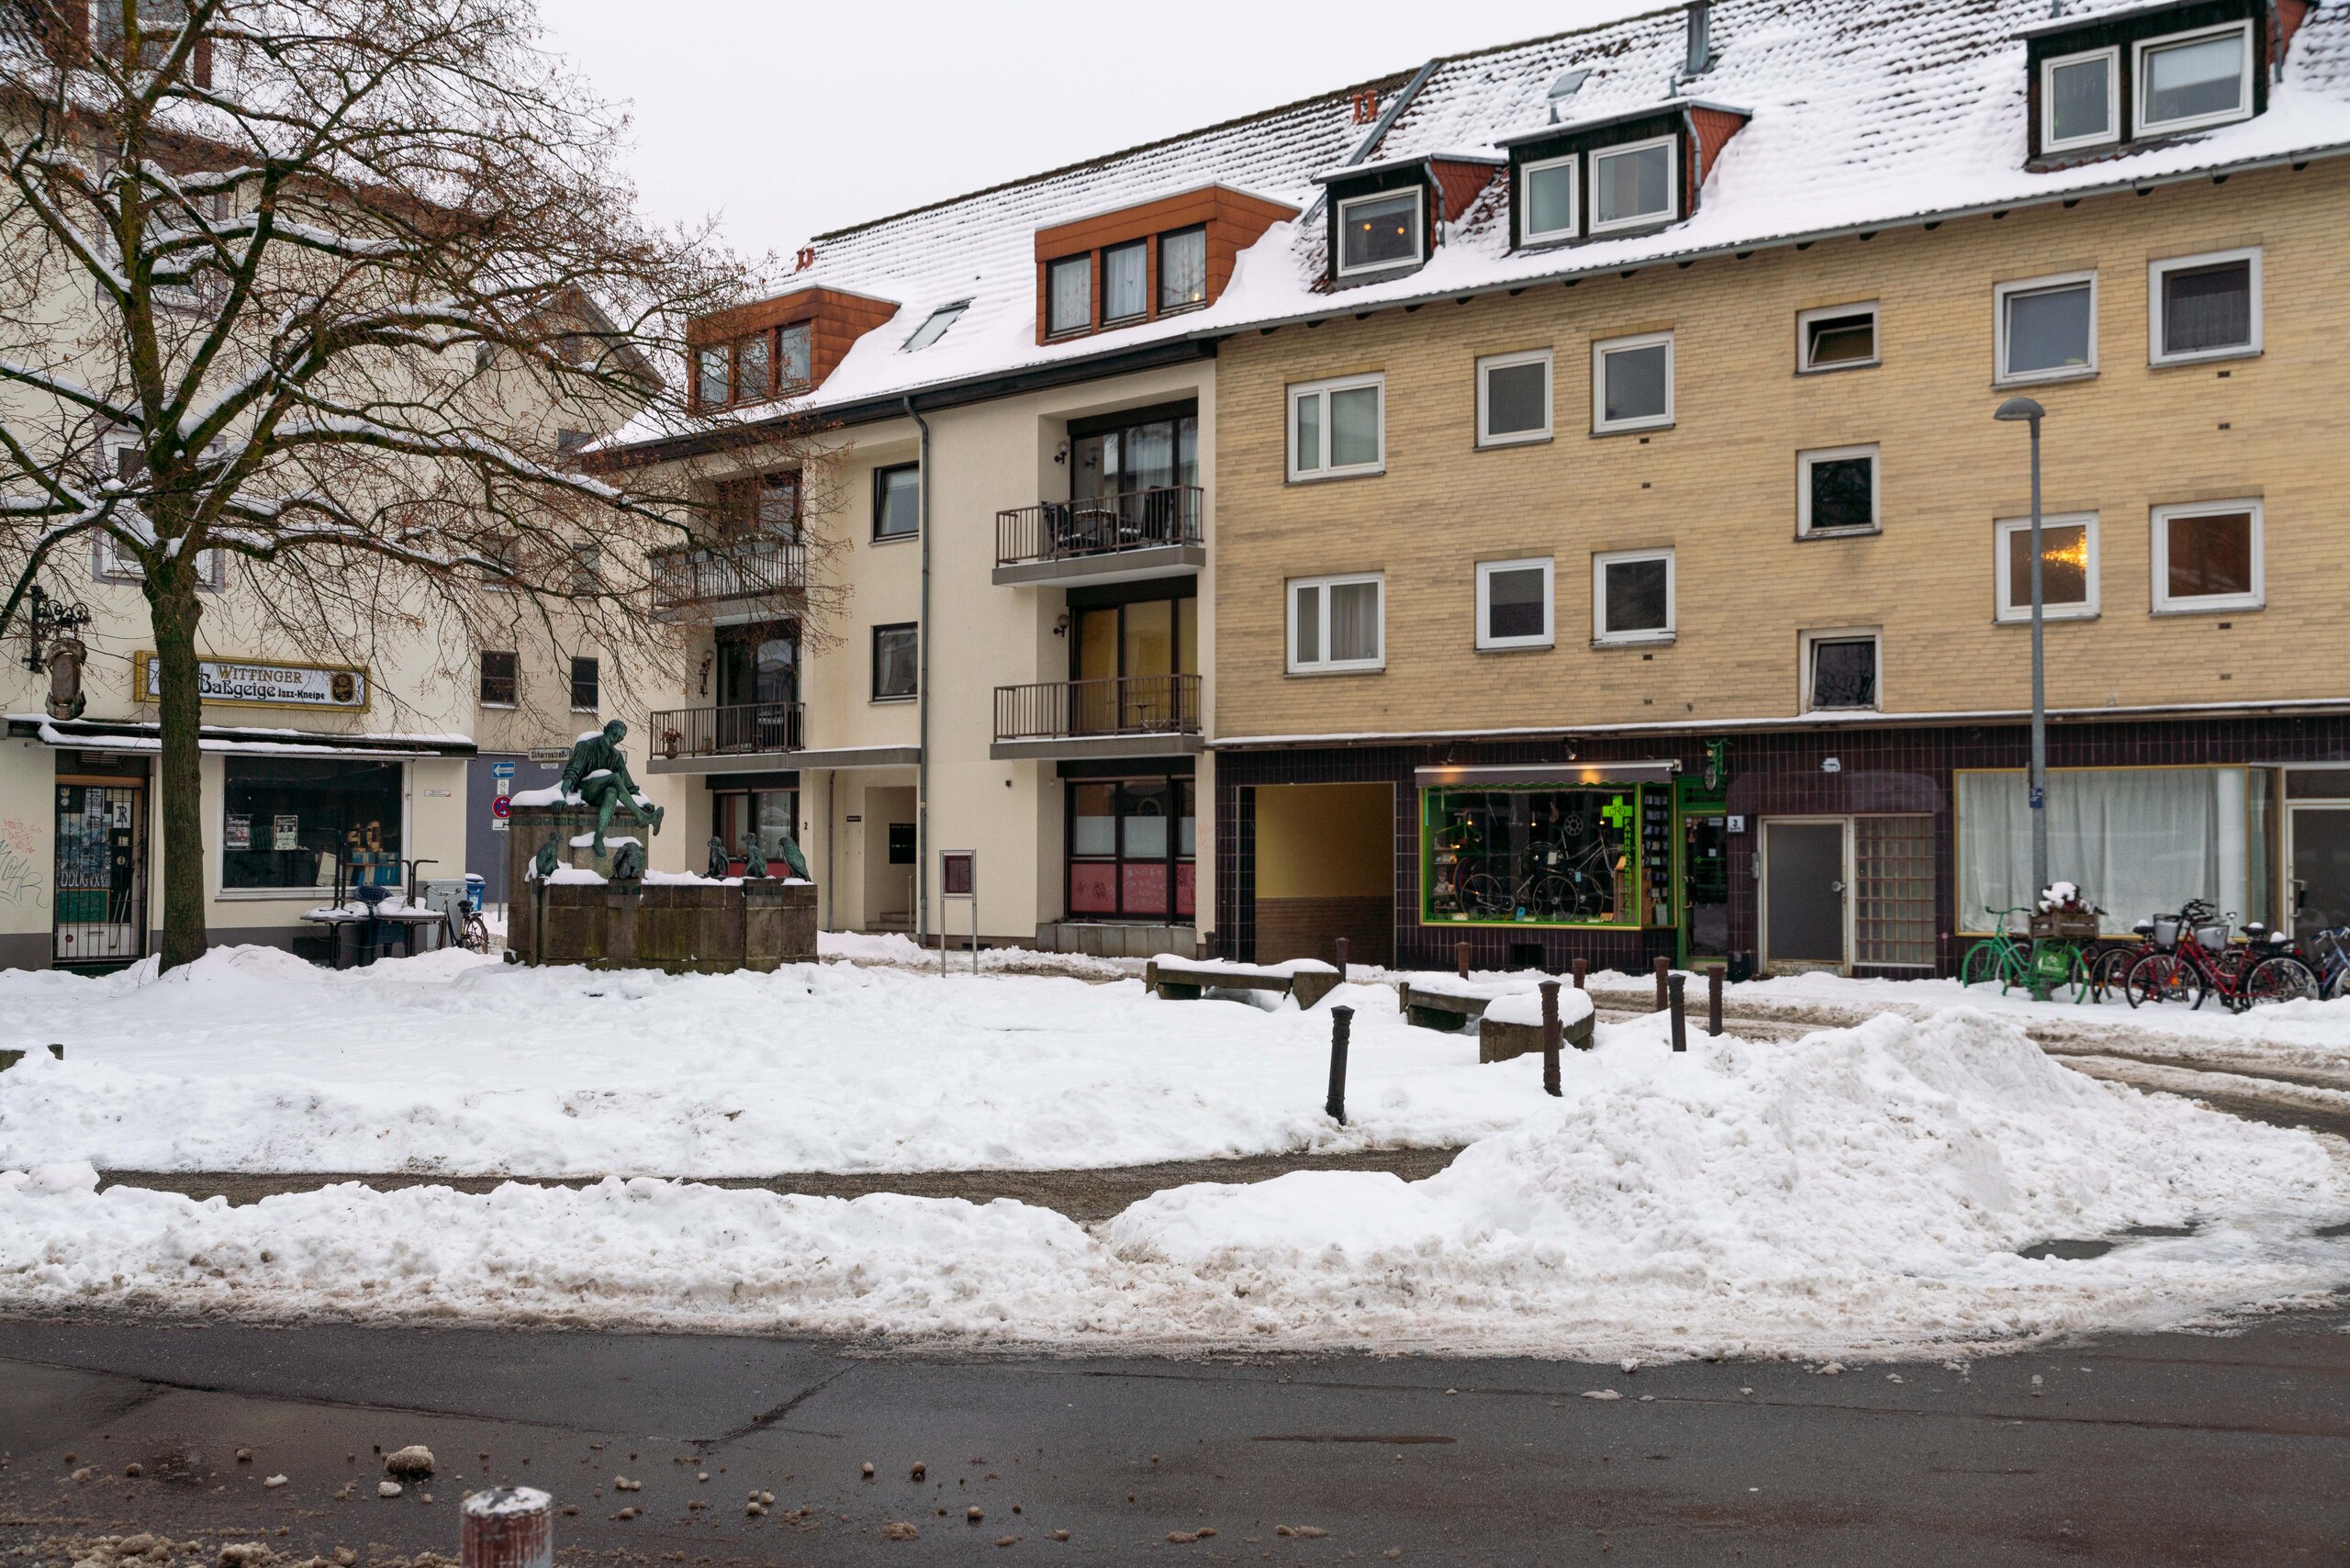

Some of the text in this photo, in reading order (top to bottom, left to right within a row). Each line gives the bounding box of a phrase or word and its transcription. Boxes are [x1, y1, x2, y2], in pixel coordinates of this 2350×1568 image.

[217, 665, 303, 684] WITTINGER
[199, 673, 326, 701] Baßgeige Jazz-Kneipe
[116, 805, 128, 823] R
[1732, 819, 1739, 827] 3
[803, 821, 809, 831] 2
